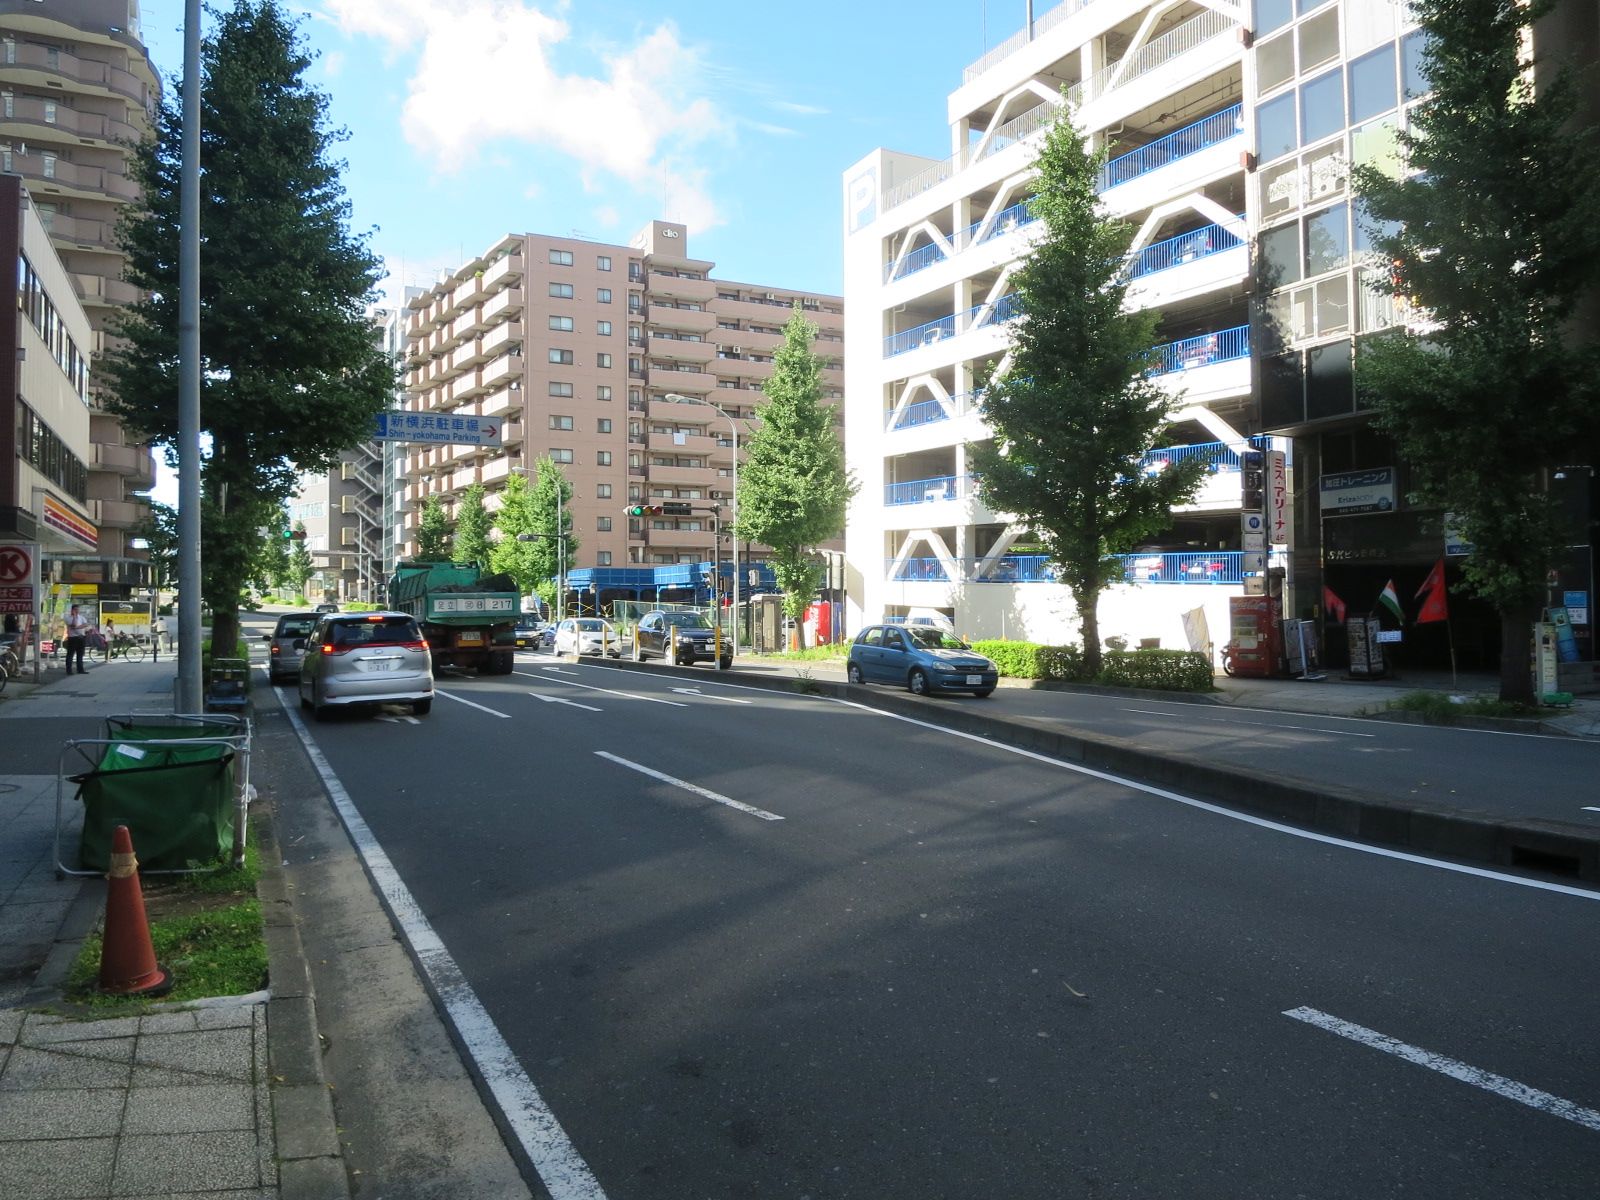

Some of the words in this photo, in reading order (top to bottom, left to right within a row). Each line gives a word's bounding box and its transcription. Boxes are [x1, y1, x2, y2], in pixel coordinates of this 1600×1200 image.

[850, 174, 875, 234] P
[391, 414, 479, 432] 新横浜駐車場
[452, 432, 481, 443] Parking
[1274, 458, 1286, 530] ミス・アリーナ
[491, 600, 511, 609] 217
